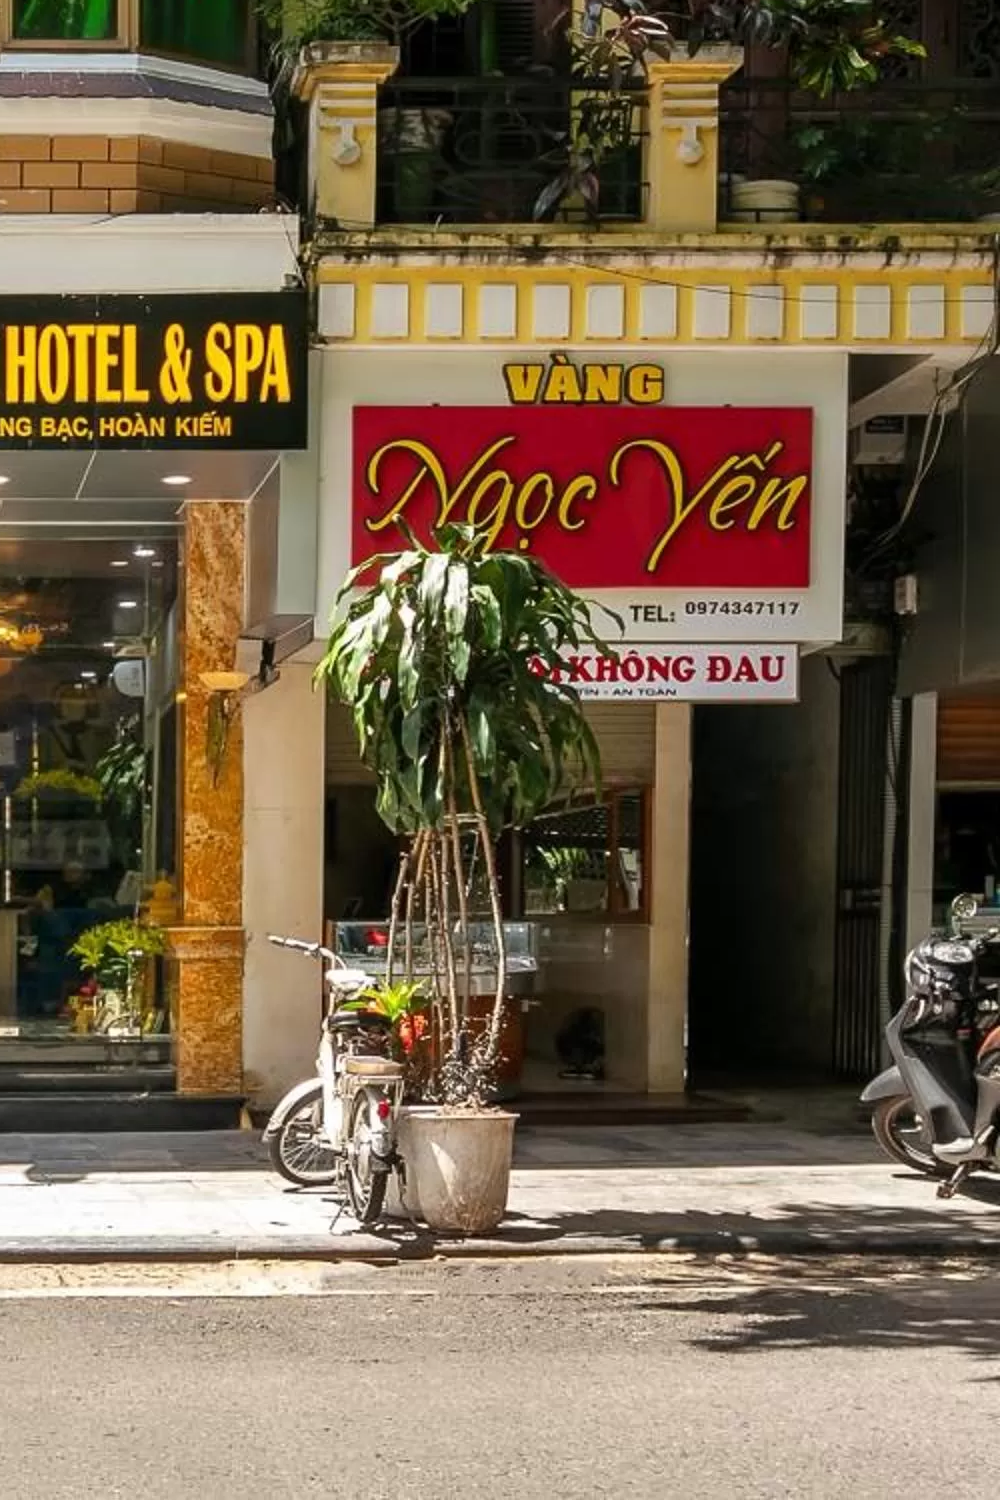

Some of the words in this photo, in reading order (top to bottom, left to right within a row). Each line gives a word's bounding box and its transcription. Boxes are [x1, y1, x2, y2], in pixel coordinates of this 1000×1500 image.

[5, 323, 149, 404] HOTEL
[159, 322, 192, 404] &
[204, 321, 291, 404] SPA
[503, 353, 665, 405] VÀNG
[99, 410, 165, 438] HOÀN
[175, 408, 232, 438] KIẾM
[366, 435, 598, 556] Ngọc
[609, 439, 809, 574] Yến
[629, 605, 677, 625] TEL:
[684, 600, 800, 617] 0974347117
[567, 650, 698, 683] KHÔNG
[706, 654, 786, 683] ĐAU
